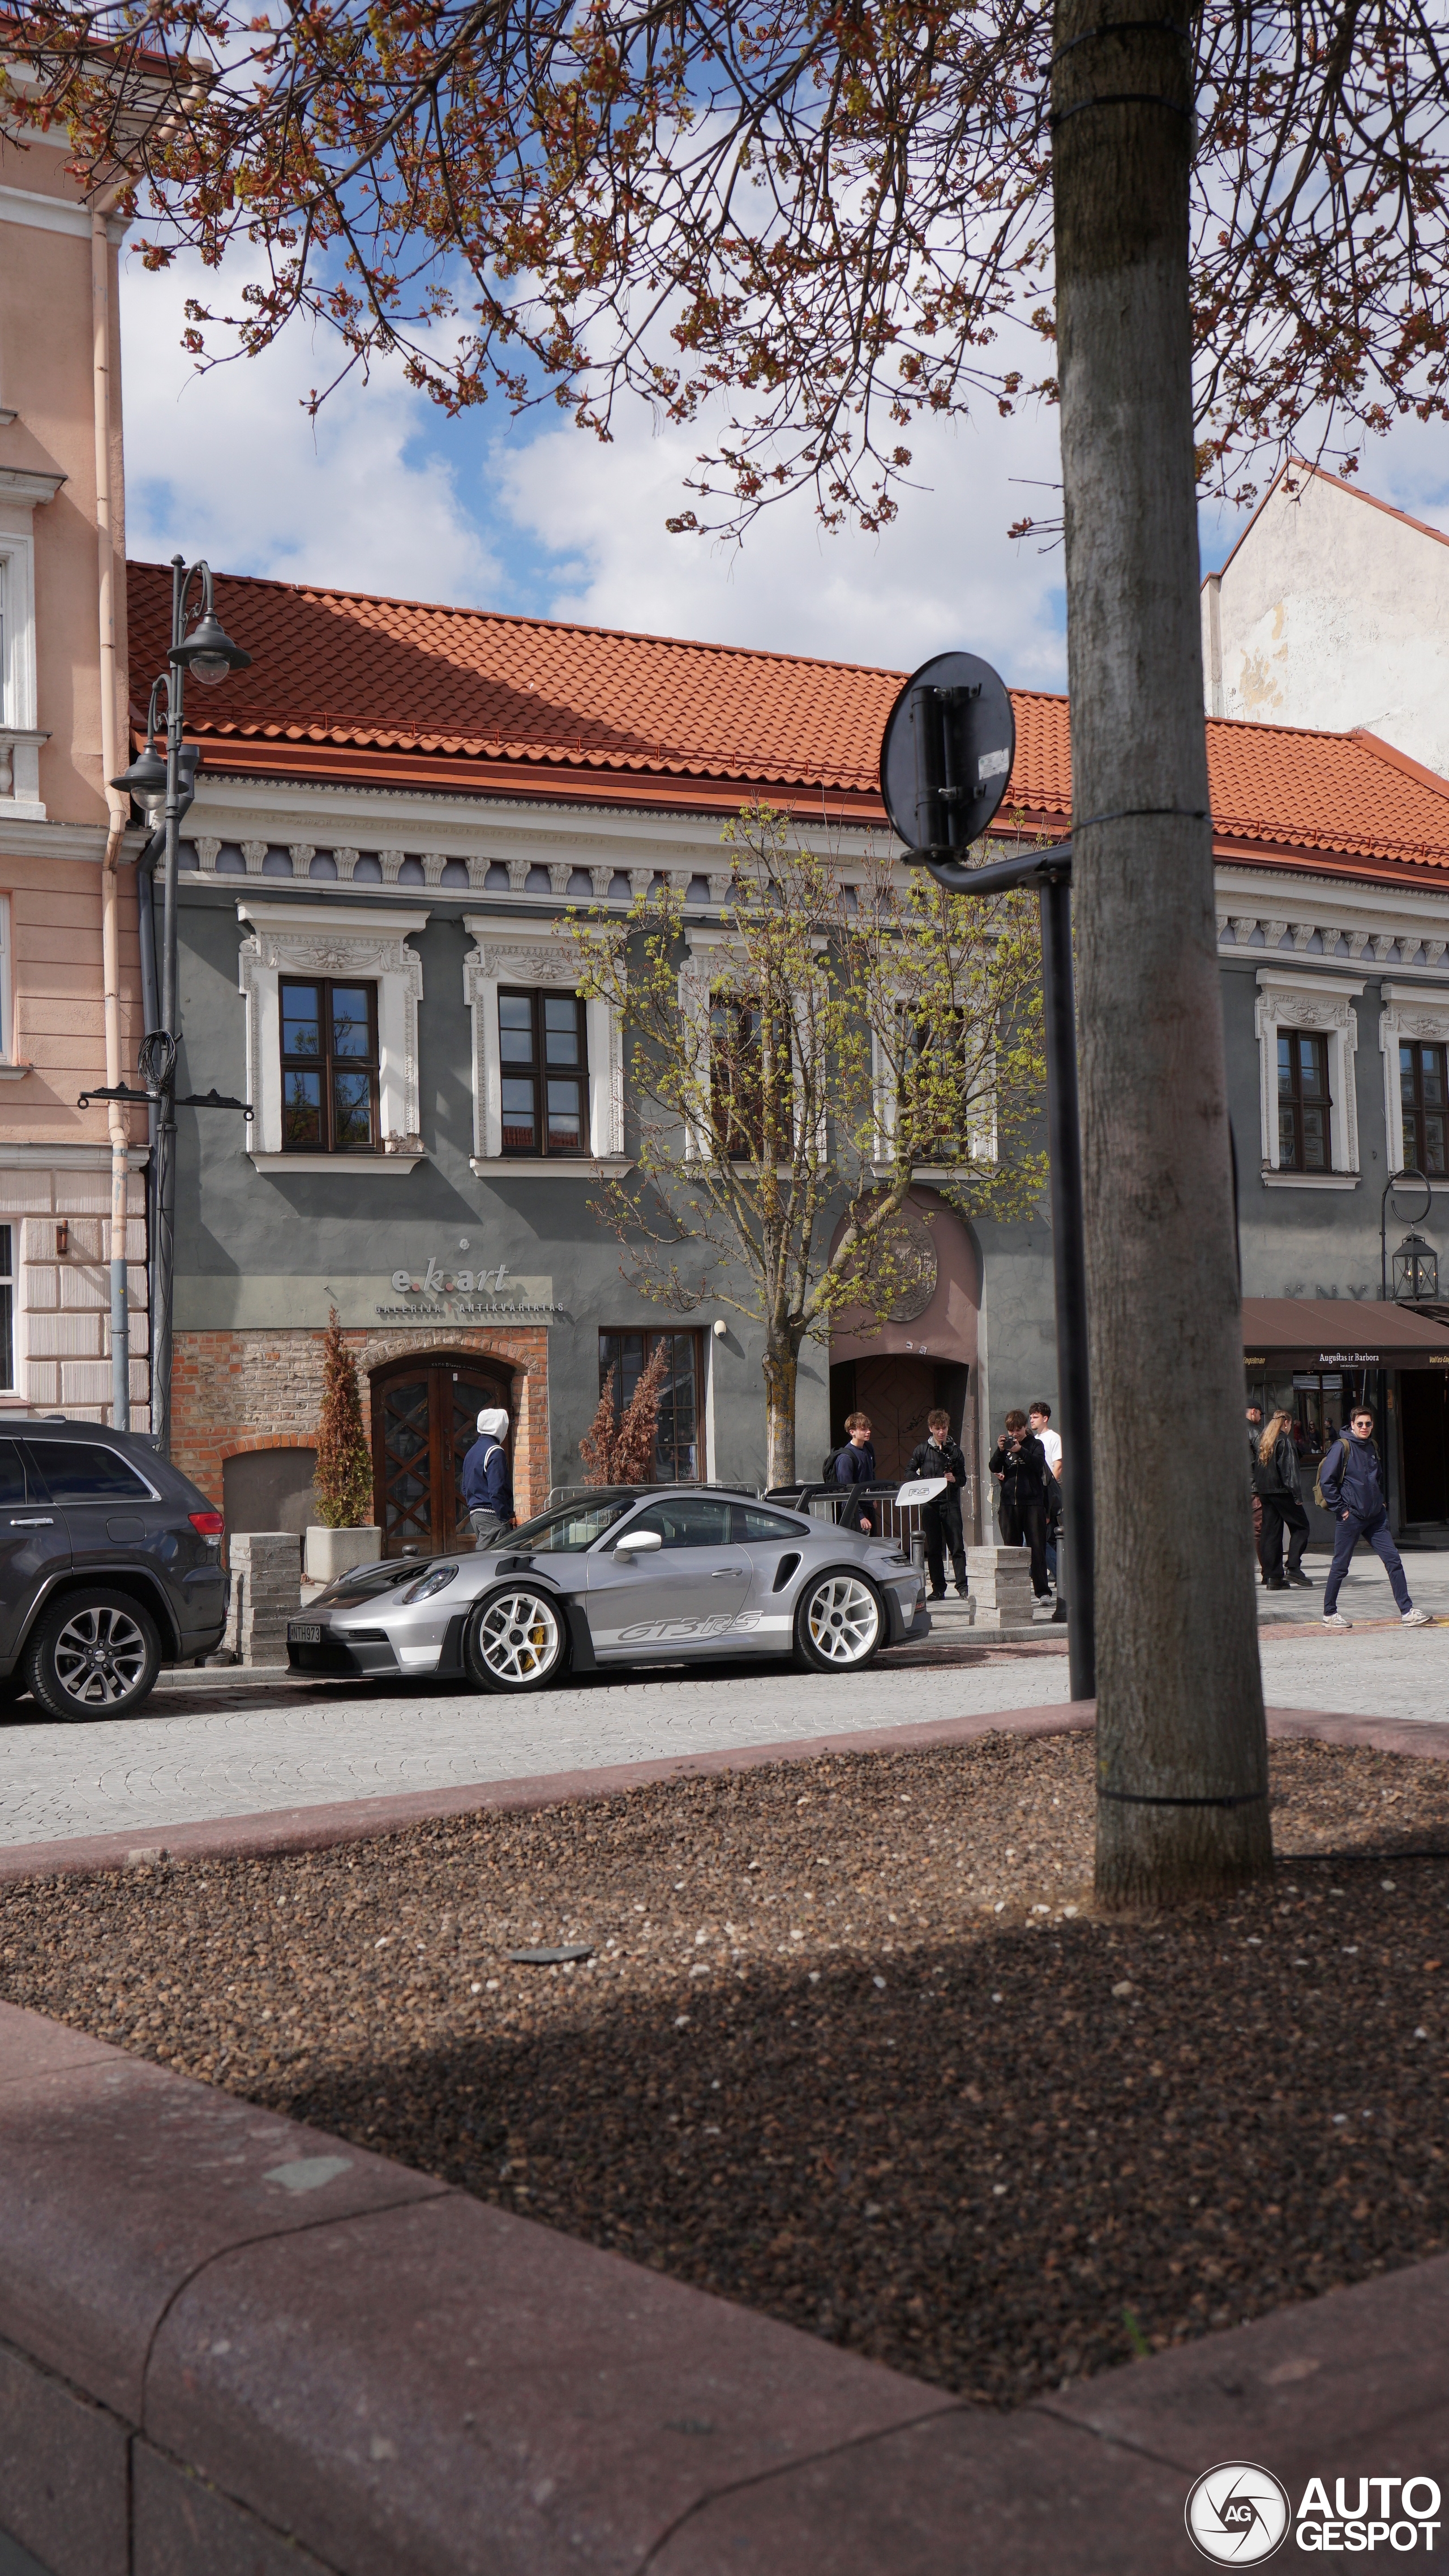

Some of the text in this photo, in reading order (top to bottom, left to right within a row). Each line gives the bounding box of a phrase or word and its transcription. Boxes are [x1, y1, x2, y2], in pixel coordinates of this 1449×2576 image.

[392, 1257, 509, 1292] e.k.art
[374, 1303, 441, 1313] GALERIJA
[459, 1302, 564, 1313] ANTIKVARIATAS
[1319, 1353, 1347, 1364] Augustas
[1354, 1353, 1379, 1361] Barbora
[908, 1488, 929, 1496] RS
[618, 1610, 764, 1641] GT3 RS
